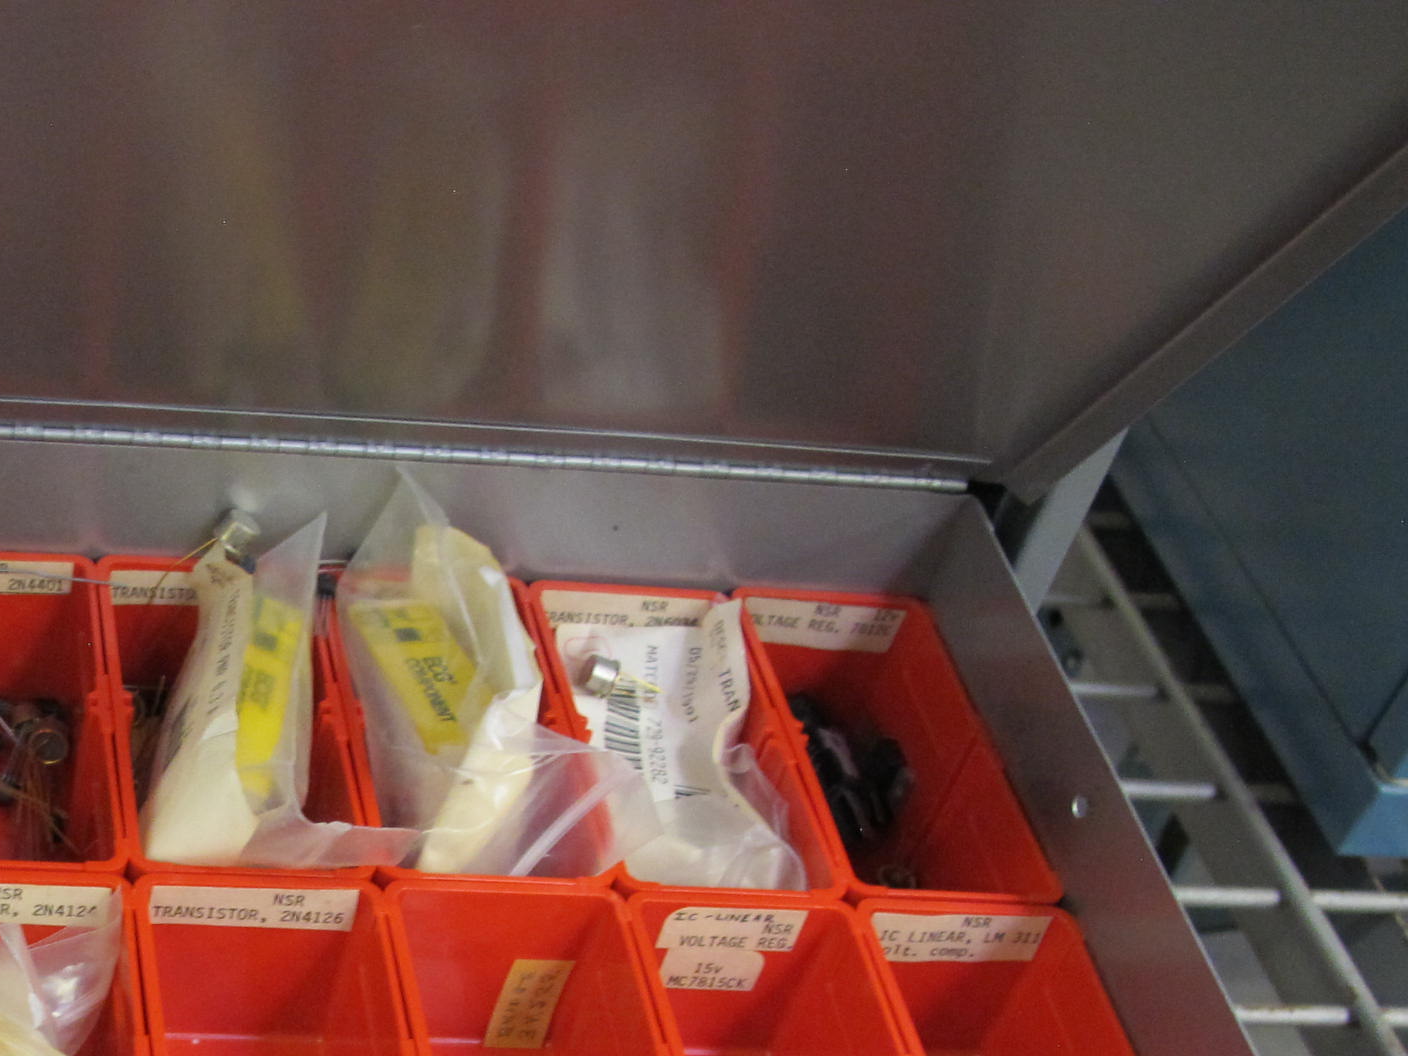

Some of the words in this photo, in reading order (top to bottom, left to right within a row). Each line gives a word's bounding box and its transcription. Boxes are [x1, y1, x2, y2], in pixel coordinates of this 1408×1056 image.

[549, 611, 634, 627] RANSISTOR,
[273, 894, 305, 906] NSR
[152, 905, 267, 923] TRANSISTOR,
[280, 910, 344, 924] 2N4126
[762, 924, 794, 934] NSR
[962, 917, 992, 928] NSR
[679, 936, 749, 949] VOLTAGE
[757, 937, 792, 949] REG.
[880, 930, 900, 941] IC
[908, 930, 972, 944] LINEAR,
[984, 932, 1005, 944] LM
[1013, 932, 1042, 944] 311
[666, 975, 749, 989] MC7815CK
